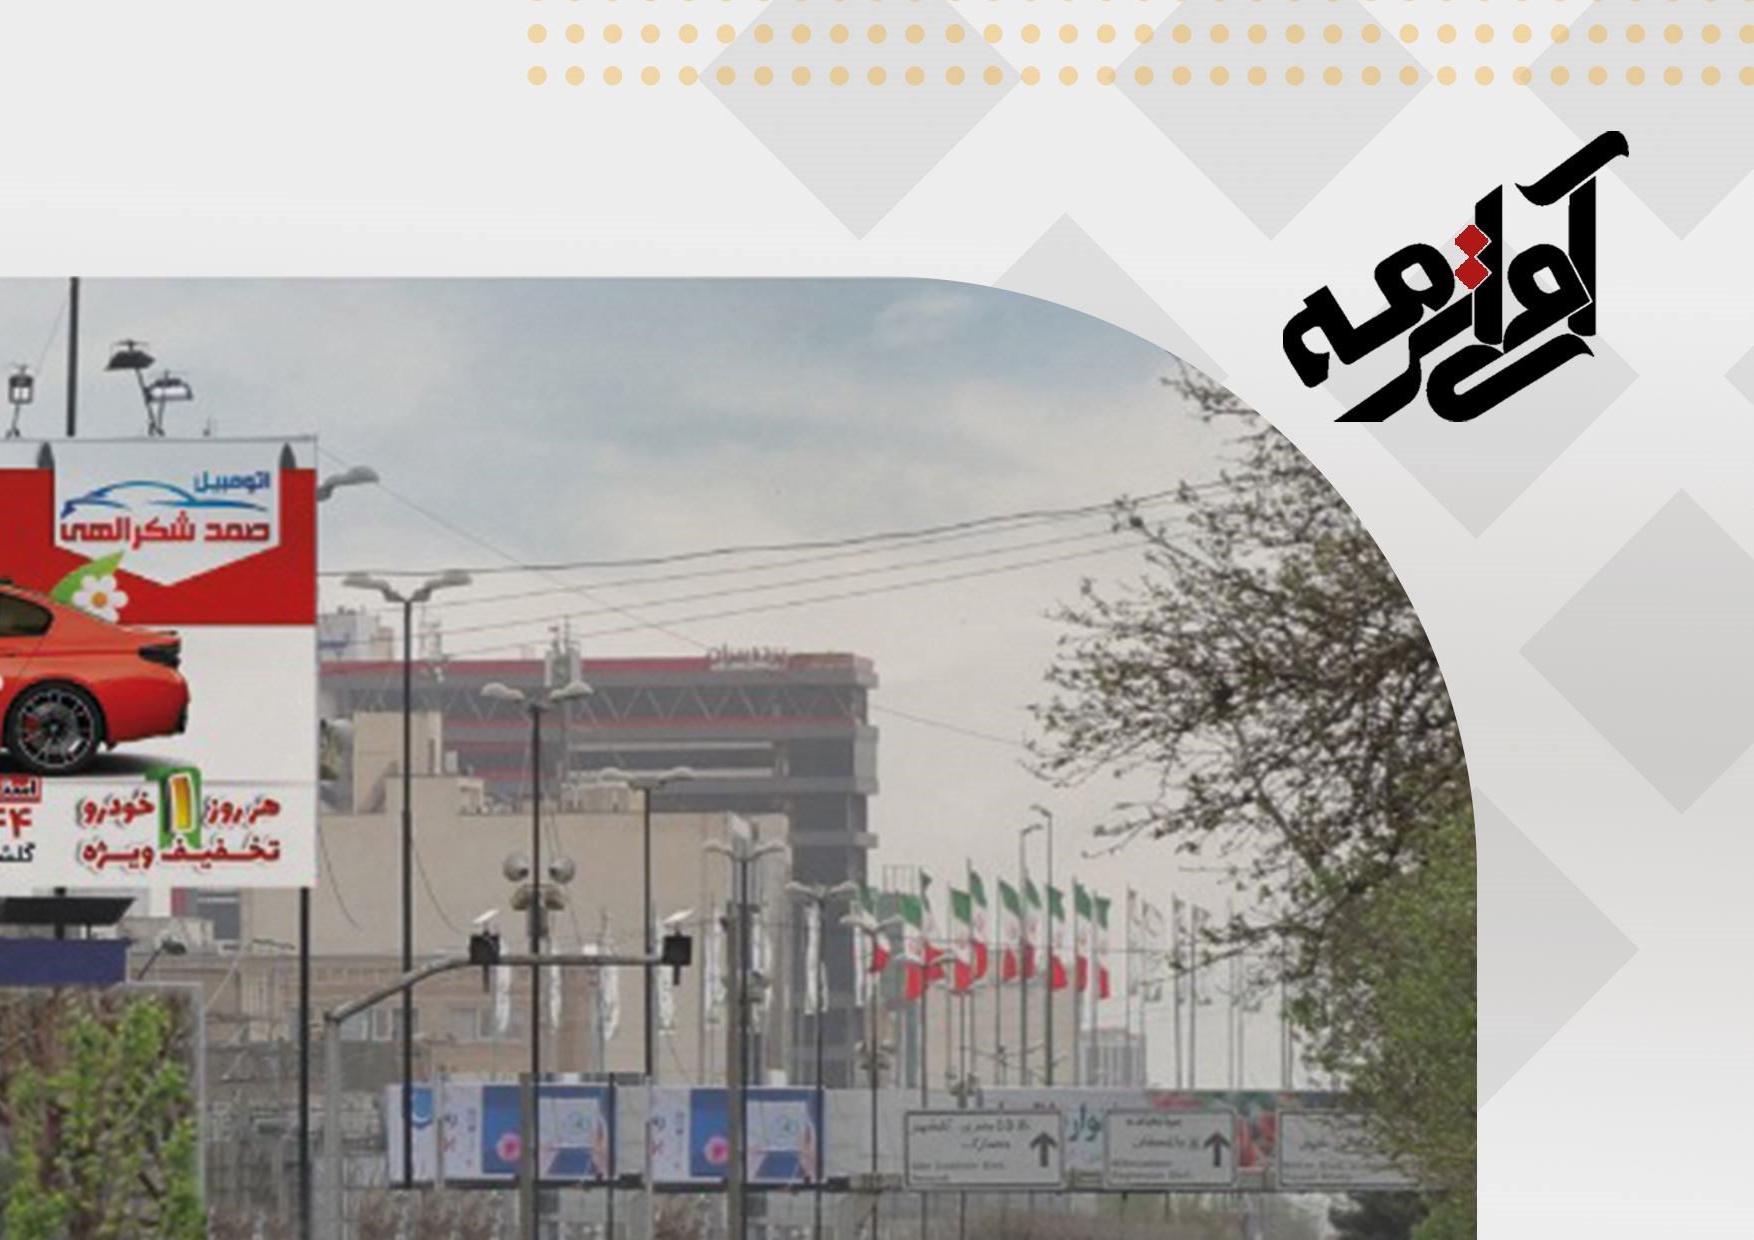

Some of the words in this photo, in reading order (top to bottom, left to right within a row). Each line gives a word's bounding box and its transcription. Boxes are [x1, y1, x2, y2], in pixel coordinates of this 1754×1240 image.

[194, 471, 270, 494] اتومبیل
[203, 521, 271, 542] صمد
[82, 790, 156, 824] خودرو
[82, 840, 156, 870] ویژه
[160, 836, 281, 869] تخفیف
